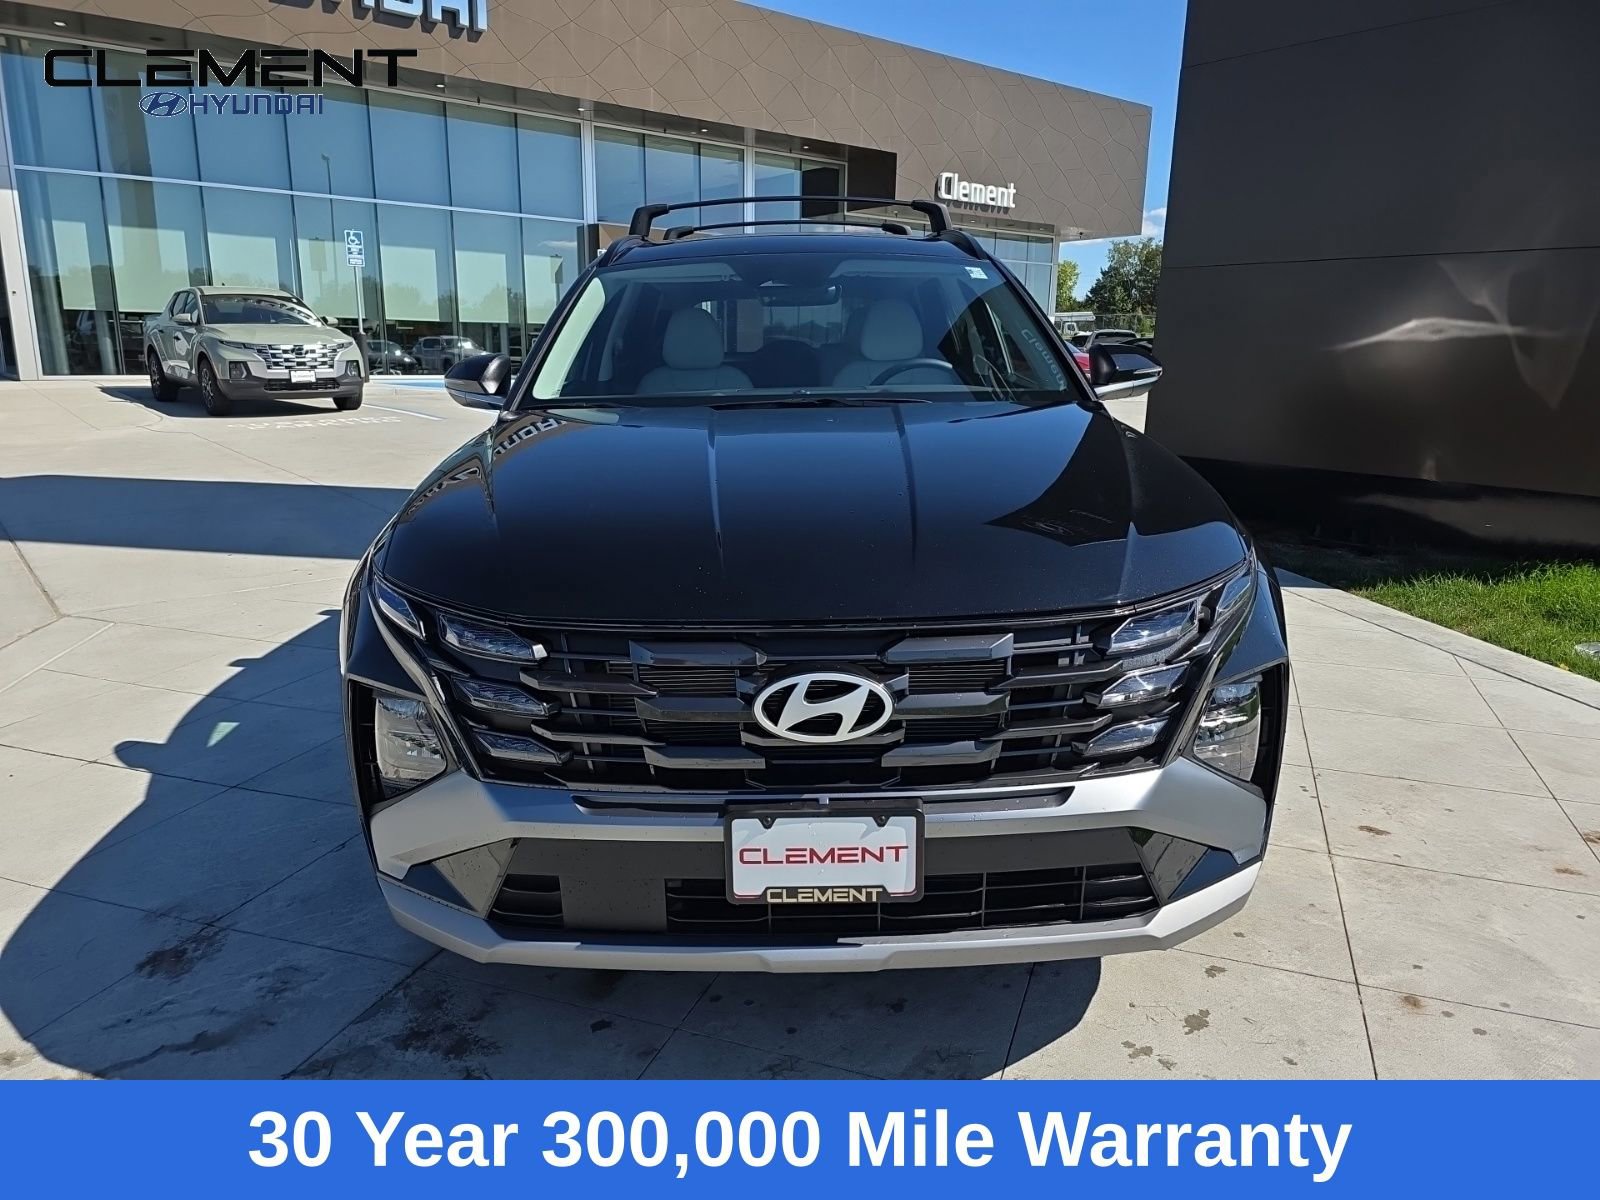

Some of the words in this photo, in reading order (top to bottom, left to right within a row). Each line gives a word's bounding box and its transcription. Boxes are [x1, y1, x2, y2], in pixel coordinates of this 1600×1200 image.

[939, 172, 1017, 208] Clement
[738, 845, 909, 865] CLEMENT
[766, 887, 883, 903] CLEMENT
